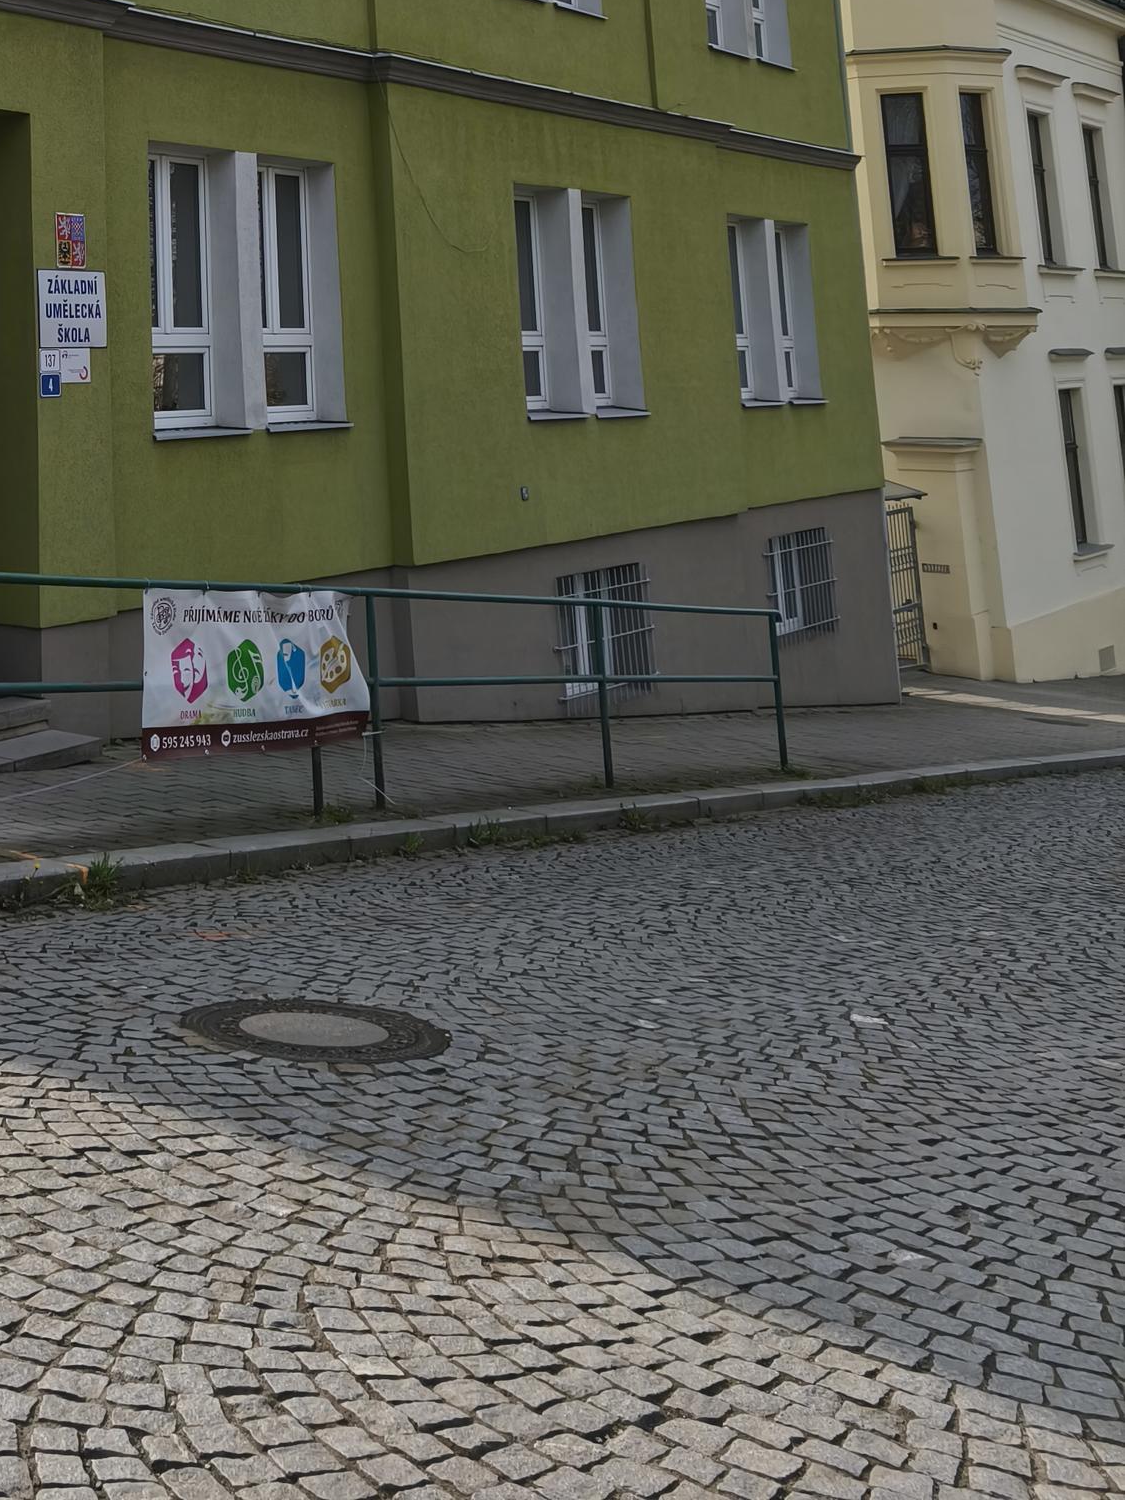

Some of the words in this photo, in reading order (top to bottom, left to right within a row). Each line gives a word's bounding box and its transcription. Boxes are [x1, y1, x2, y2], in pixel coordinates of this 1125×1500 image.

[47, 274, 97, 295] ZÁKLADNÍ
[45, 300, 101, 319] UMĚLECKÁ
[57, 324, 90, 343] ŠKOLA
[45, 354, 56, 368] 137
[183, 605, 241, 624] PŘIJÍMÁME
[162, 736, 178, 749] 595
[179, 735, 194, 748] 245
[196, 734, 211, 747] 943
[232, 729, 309, 743] zusslezskaostrava.cz
